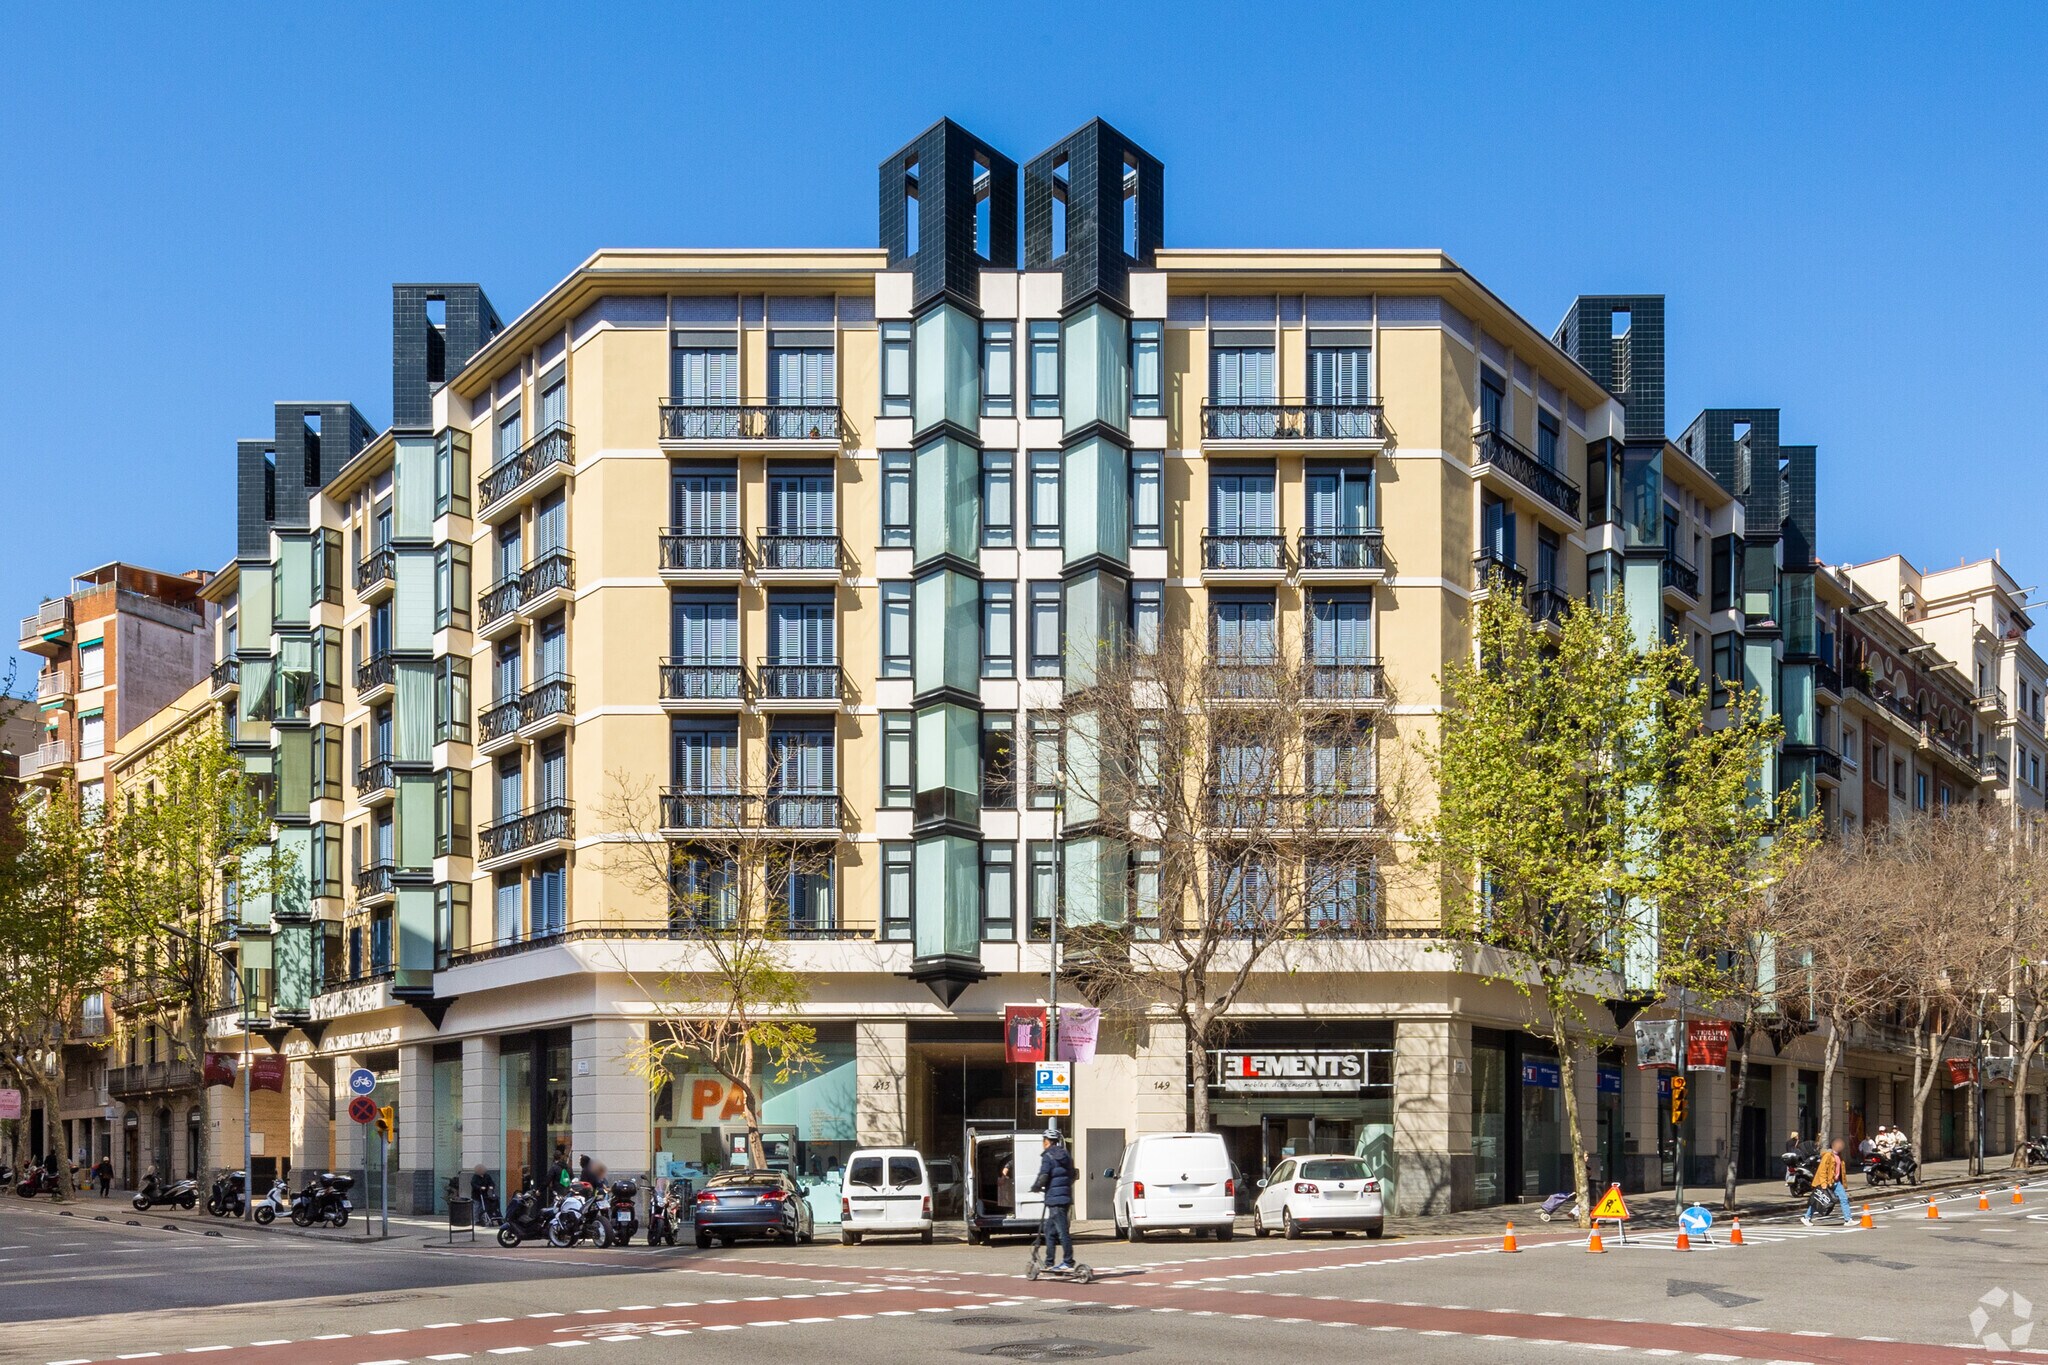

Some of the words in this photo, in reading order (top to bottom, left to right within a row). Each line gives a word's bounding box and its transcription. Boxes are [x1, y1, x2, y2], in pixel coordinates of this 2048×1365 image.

[1225, 1055, 1360, 1077] ELEMENTS
[1040, 1072, 1050, 1084] P
[872, 1080, 891, 1091] 413
[1154, 1080, 1171, 1091] 149
[692, 1079, 763, 1121] PA
